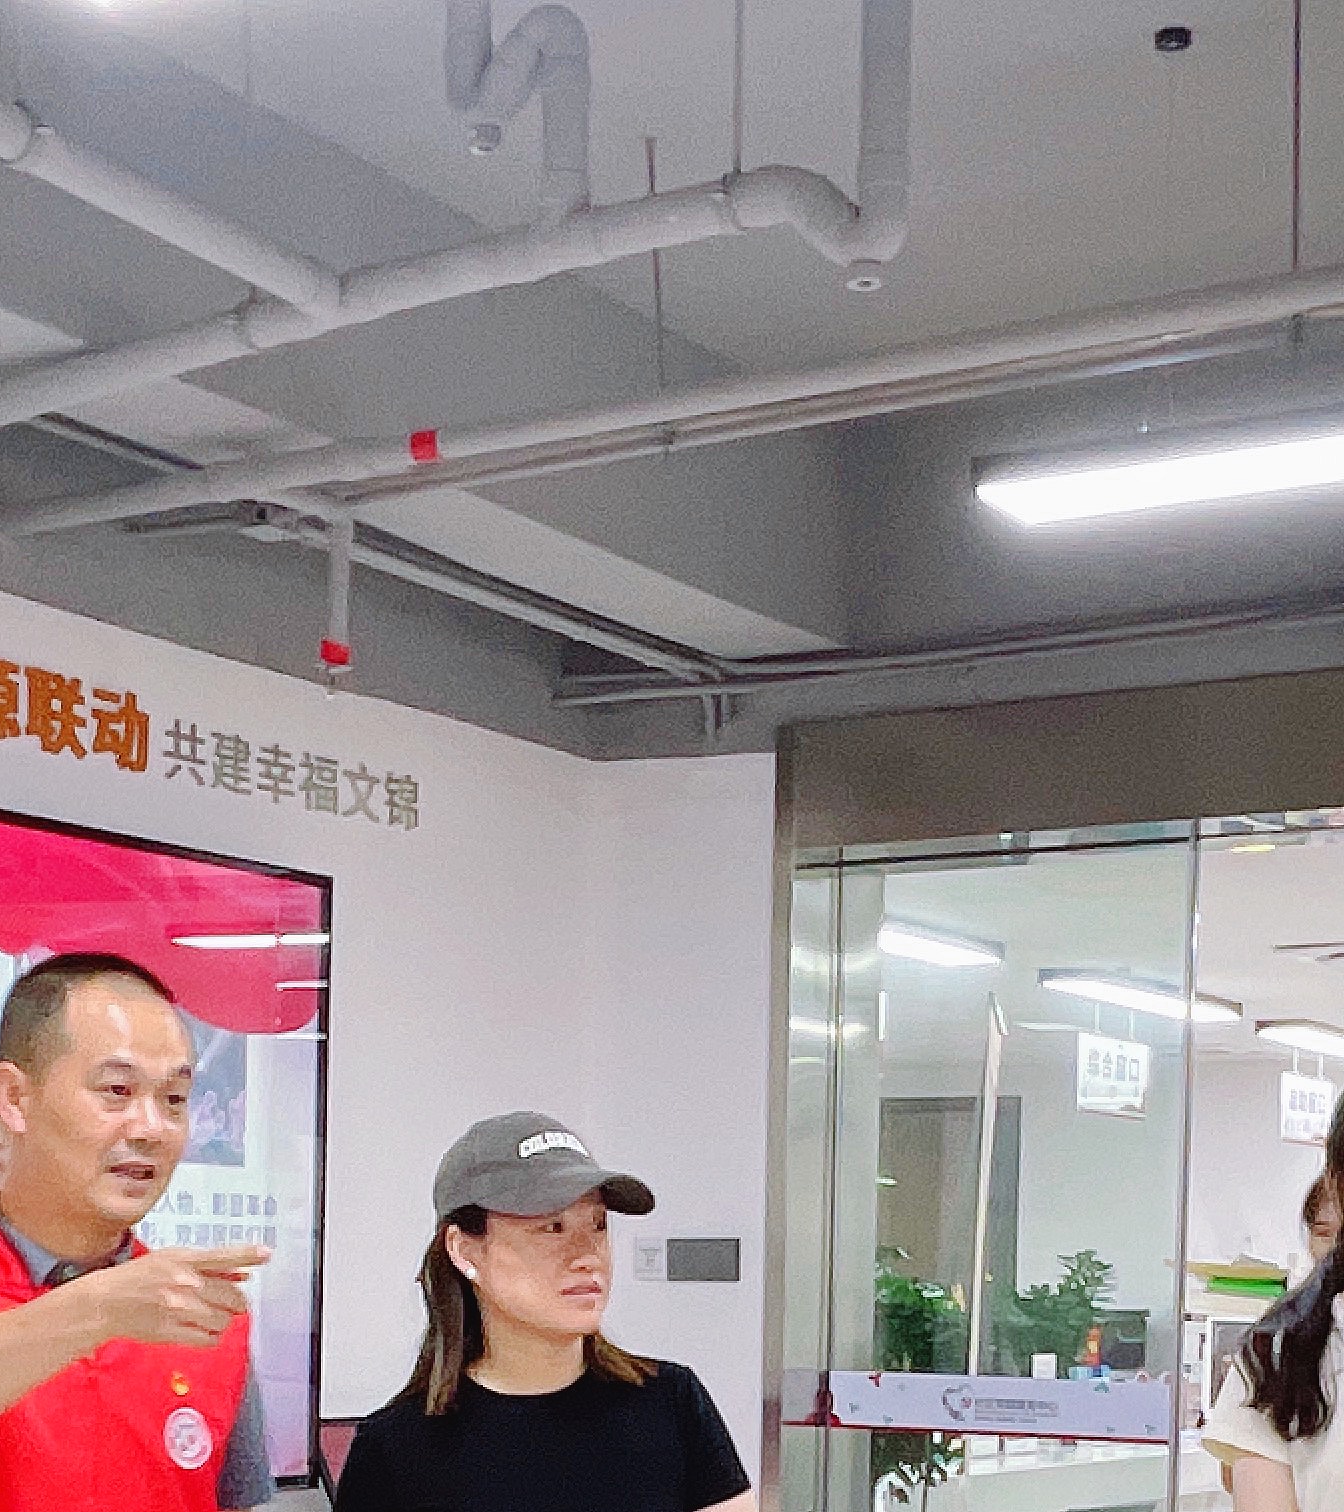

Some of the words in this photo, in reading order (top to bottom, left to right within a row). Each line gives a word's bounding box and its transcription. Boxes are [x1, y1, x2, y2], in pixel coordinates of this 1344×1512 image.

[162, 718, 421, 832] 共建幸福文锦
